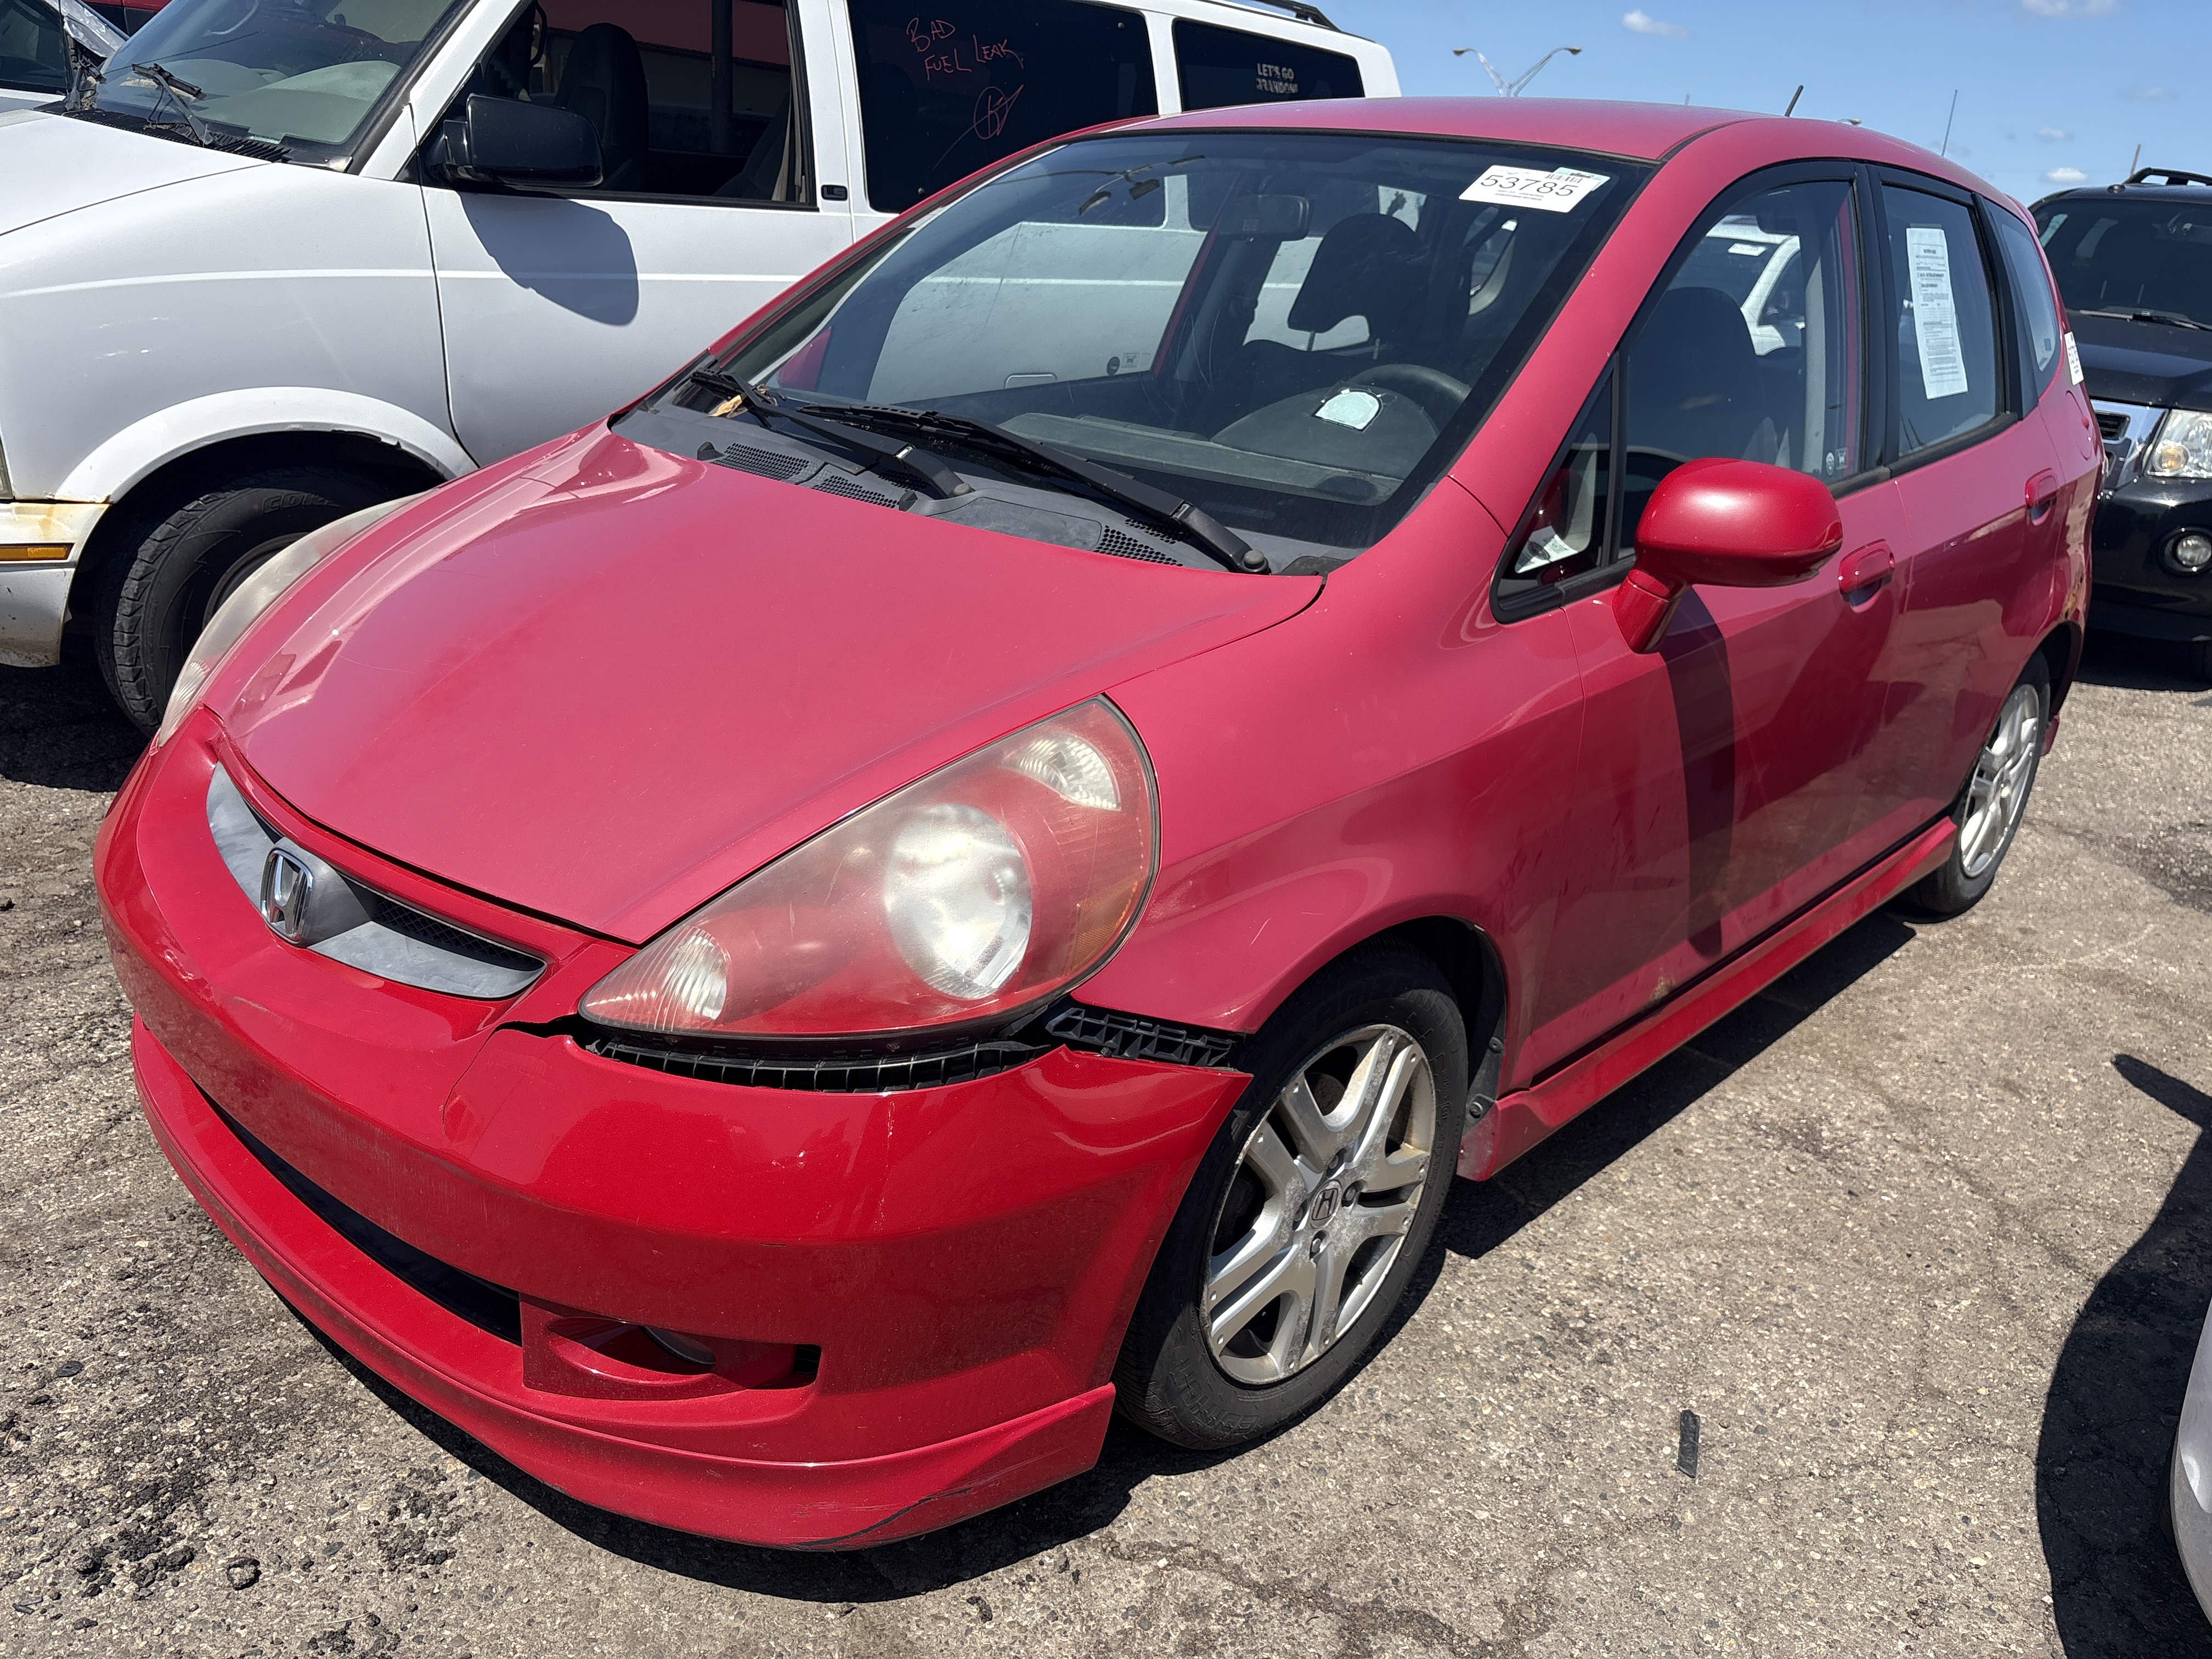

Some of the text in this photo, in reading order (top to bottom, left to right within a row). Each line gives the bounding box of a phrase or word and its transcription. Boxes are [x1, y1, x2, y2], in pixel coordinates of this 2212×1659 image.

[906, 18, 956, 53] BAD
[924, 34, 1024, 81] FUEL LEAK
[1282, 67, 1295, 80] GO
[823, 187, 846, 199] LS
[1480, 174, 1579, 196] 53785
